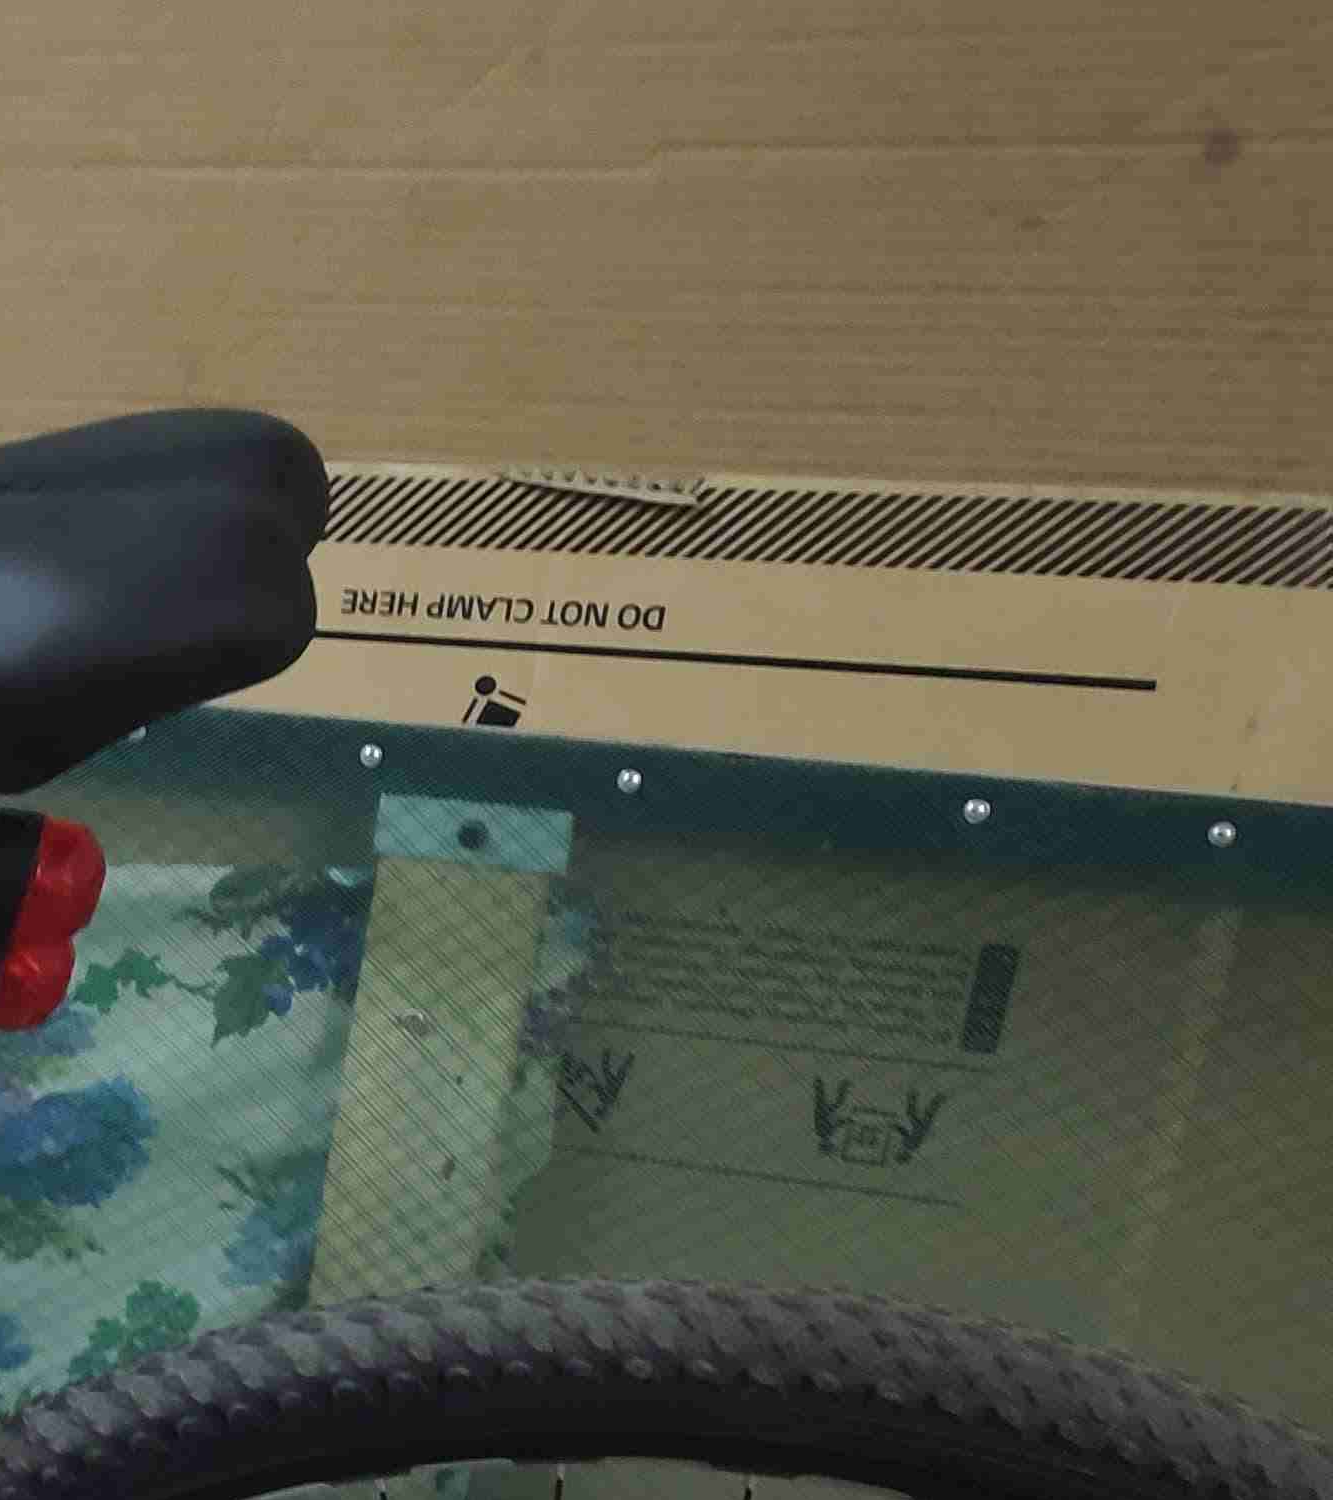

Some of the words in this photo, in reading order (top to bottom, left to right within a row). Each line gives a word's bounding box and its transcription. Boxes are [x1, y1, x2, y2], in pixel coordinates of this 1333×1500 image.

[340, 588, 420, 617] HERE
[426, 592, 535, 625] CLAMP
[541, 599, 610, 628] NOT
[618, 602, 666, 632] DO
